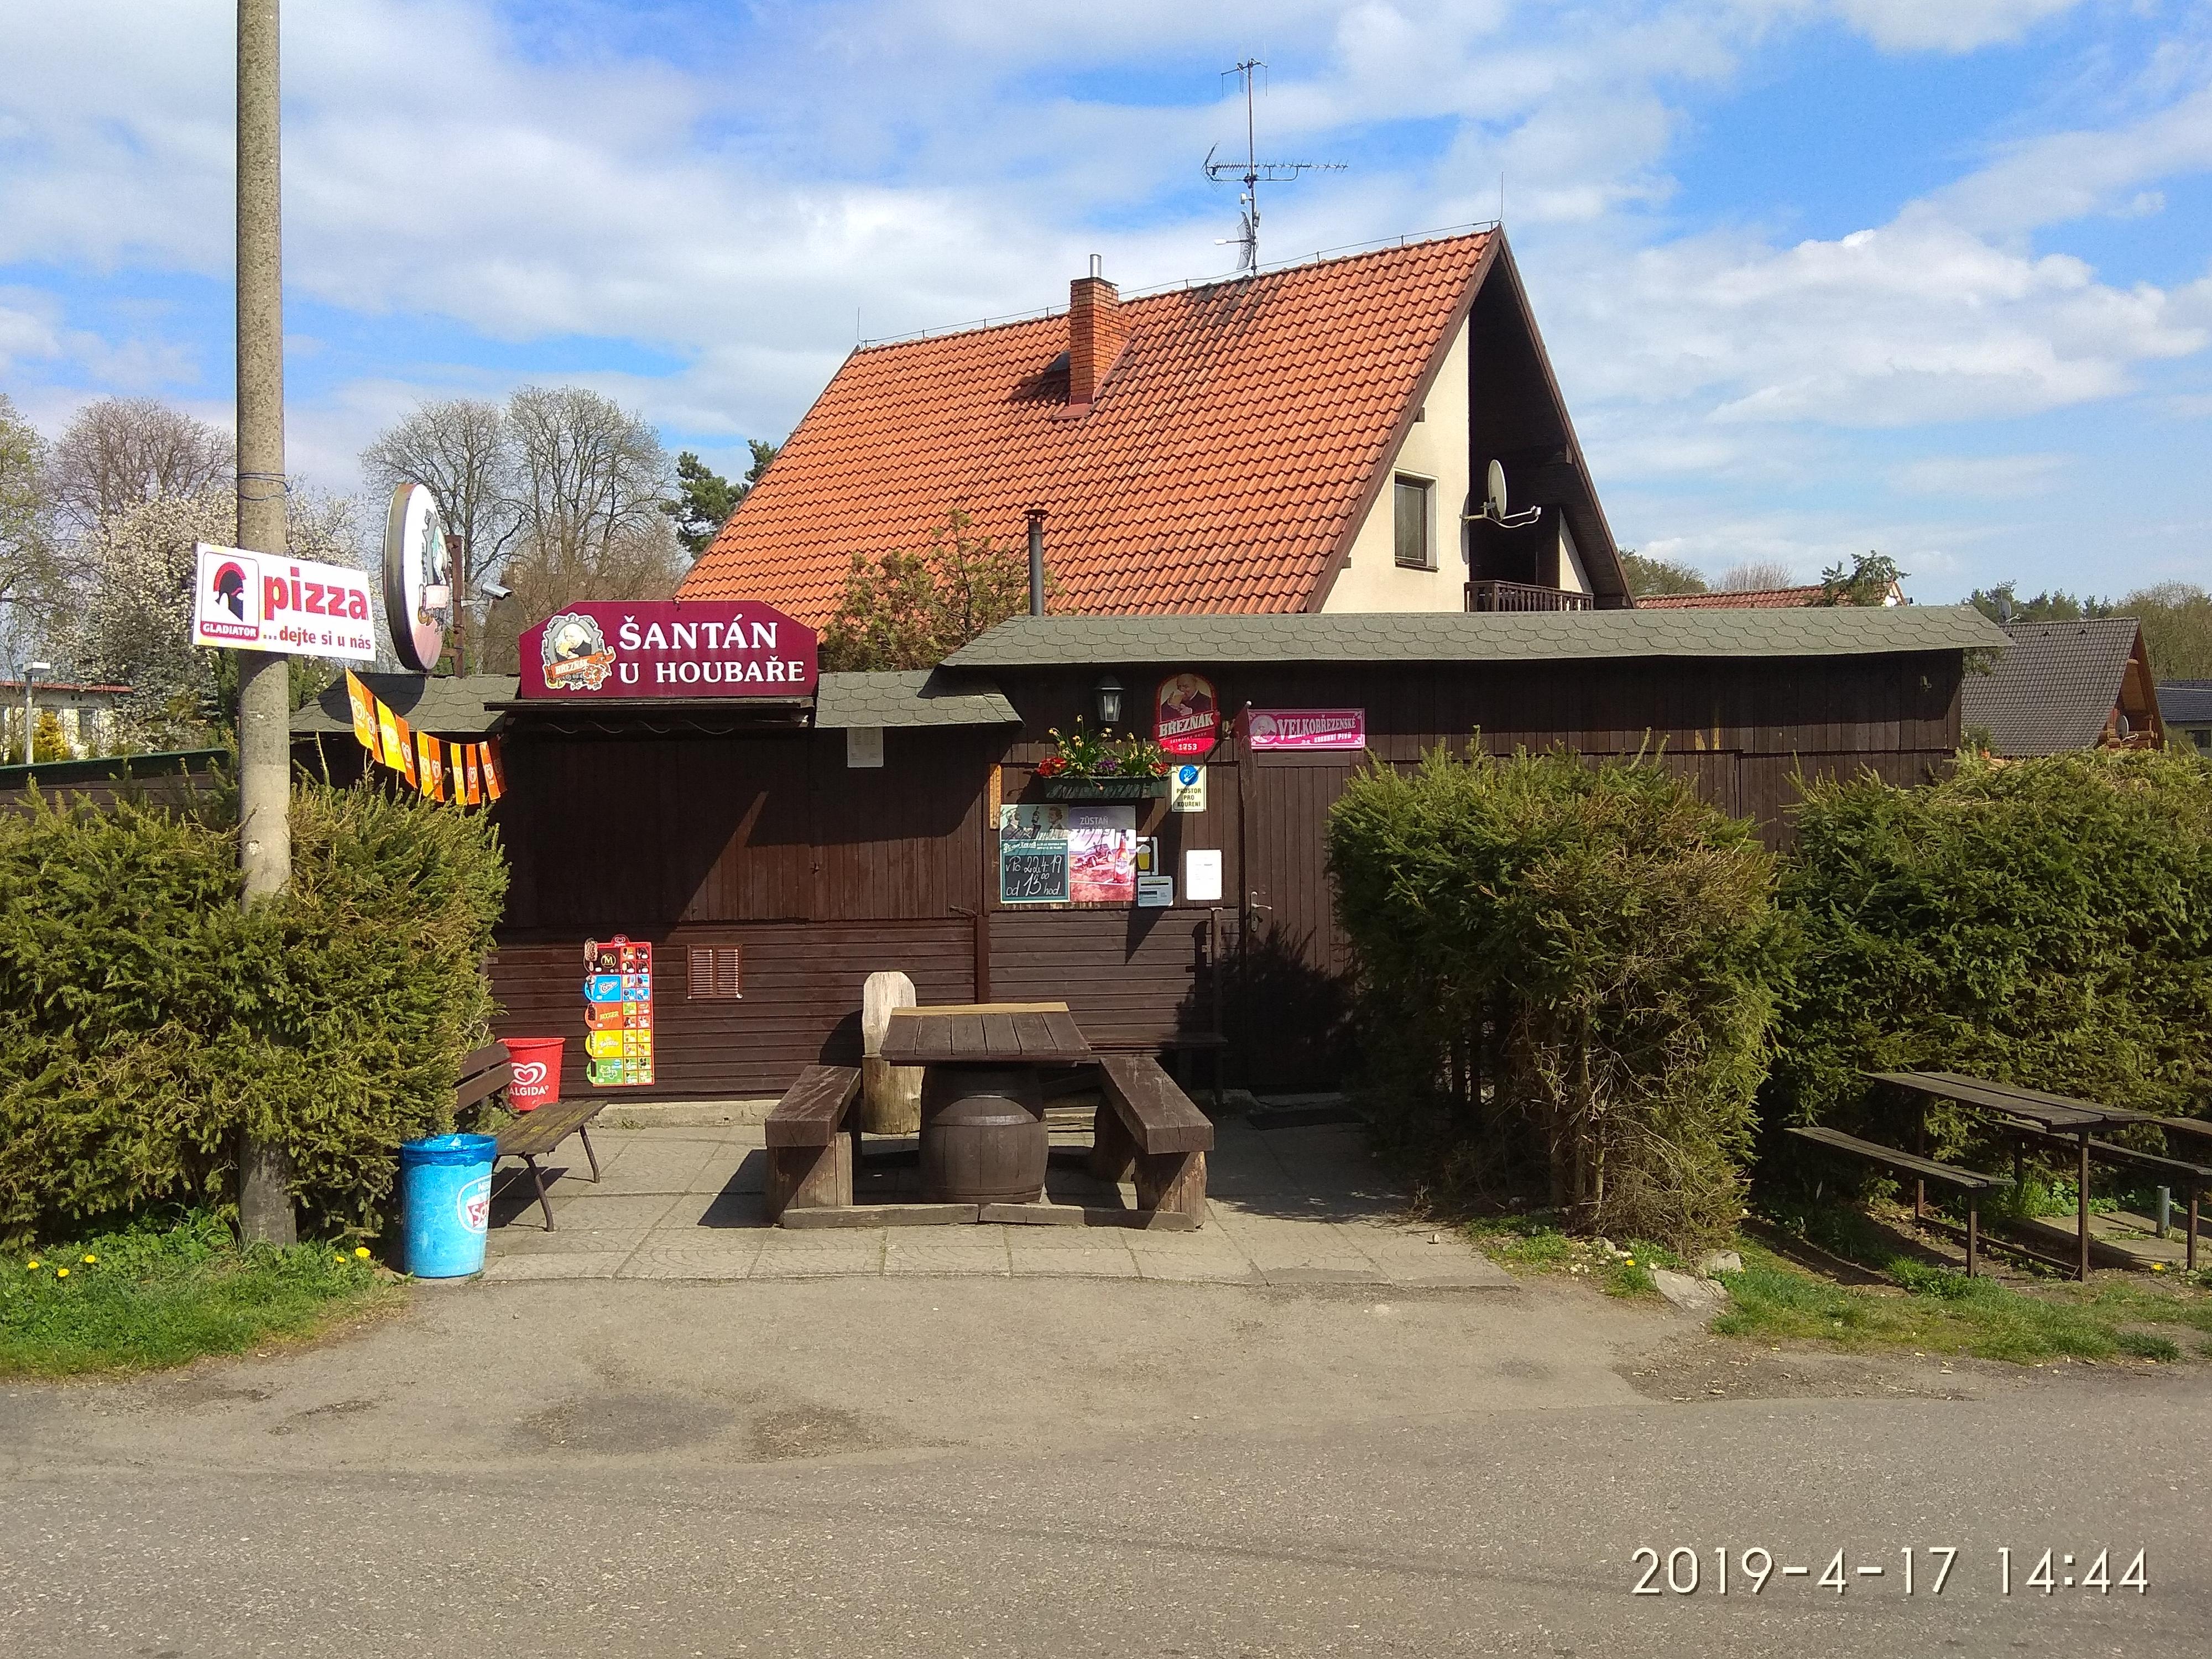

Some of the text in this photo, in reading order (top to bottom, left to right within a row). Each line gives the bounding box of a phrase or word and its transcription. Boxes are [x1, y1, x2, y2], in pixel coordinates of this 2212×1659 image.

[264, 566, 369, 620] pizza
[202, 623, 257, 637] GLADIATOR
[321, 630, 332, 645] si
[337, 636, 345, 647] u
[350, 634, 371, 650] nás
[619, 613, 778, 650] ŠANTÁN
[619, 656, 806, 684] U HOUBAŘE
[1277, 714, 1356, 741] VELKOBŘEZENSKÉ
[1006, 880, 1020, 896] od
[509, 1086, 546, 1096] ALGIDA
